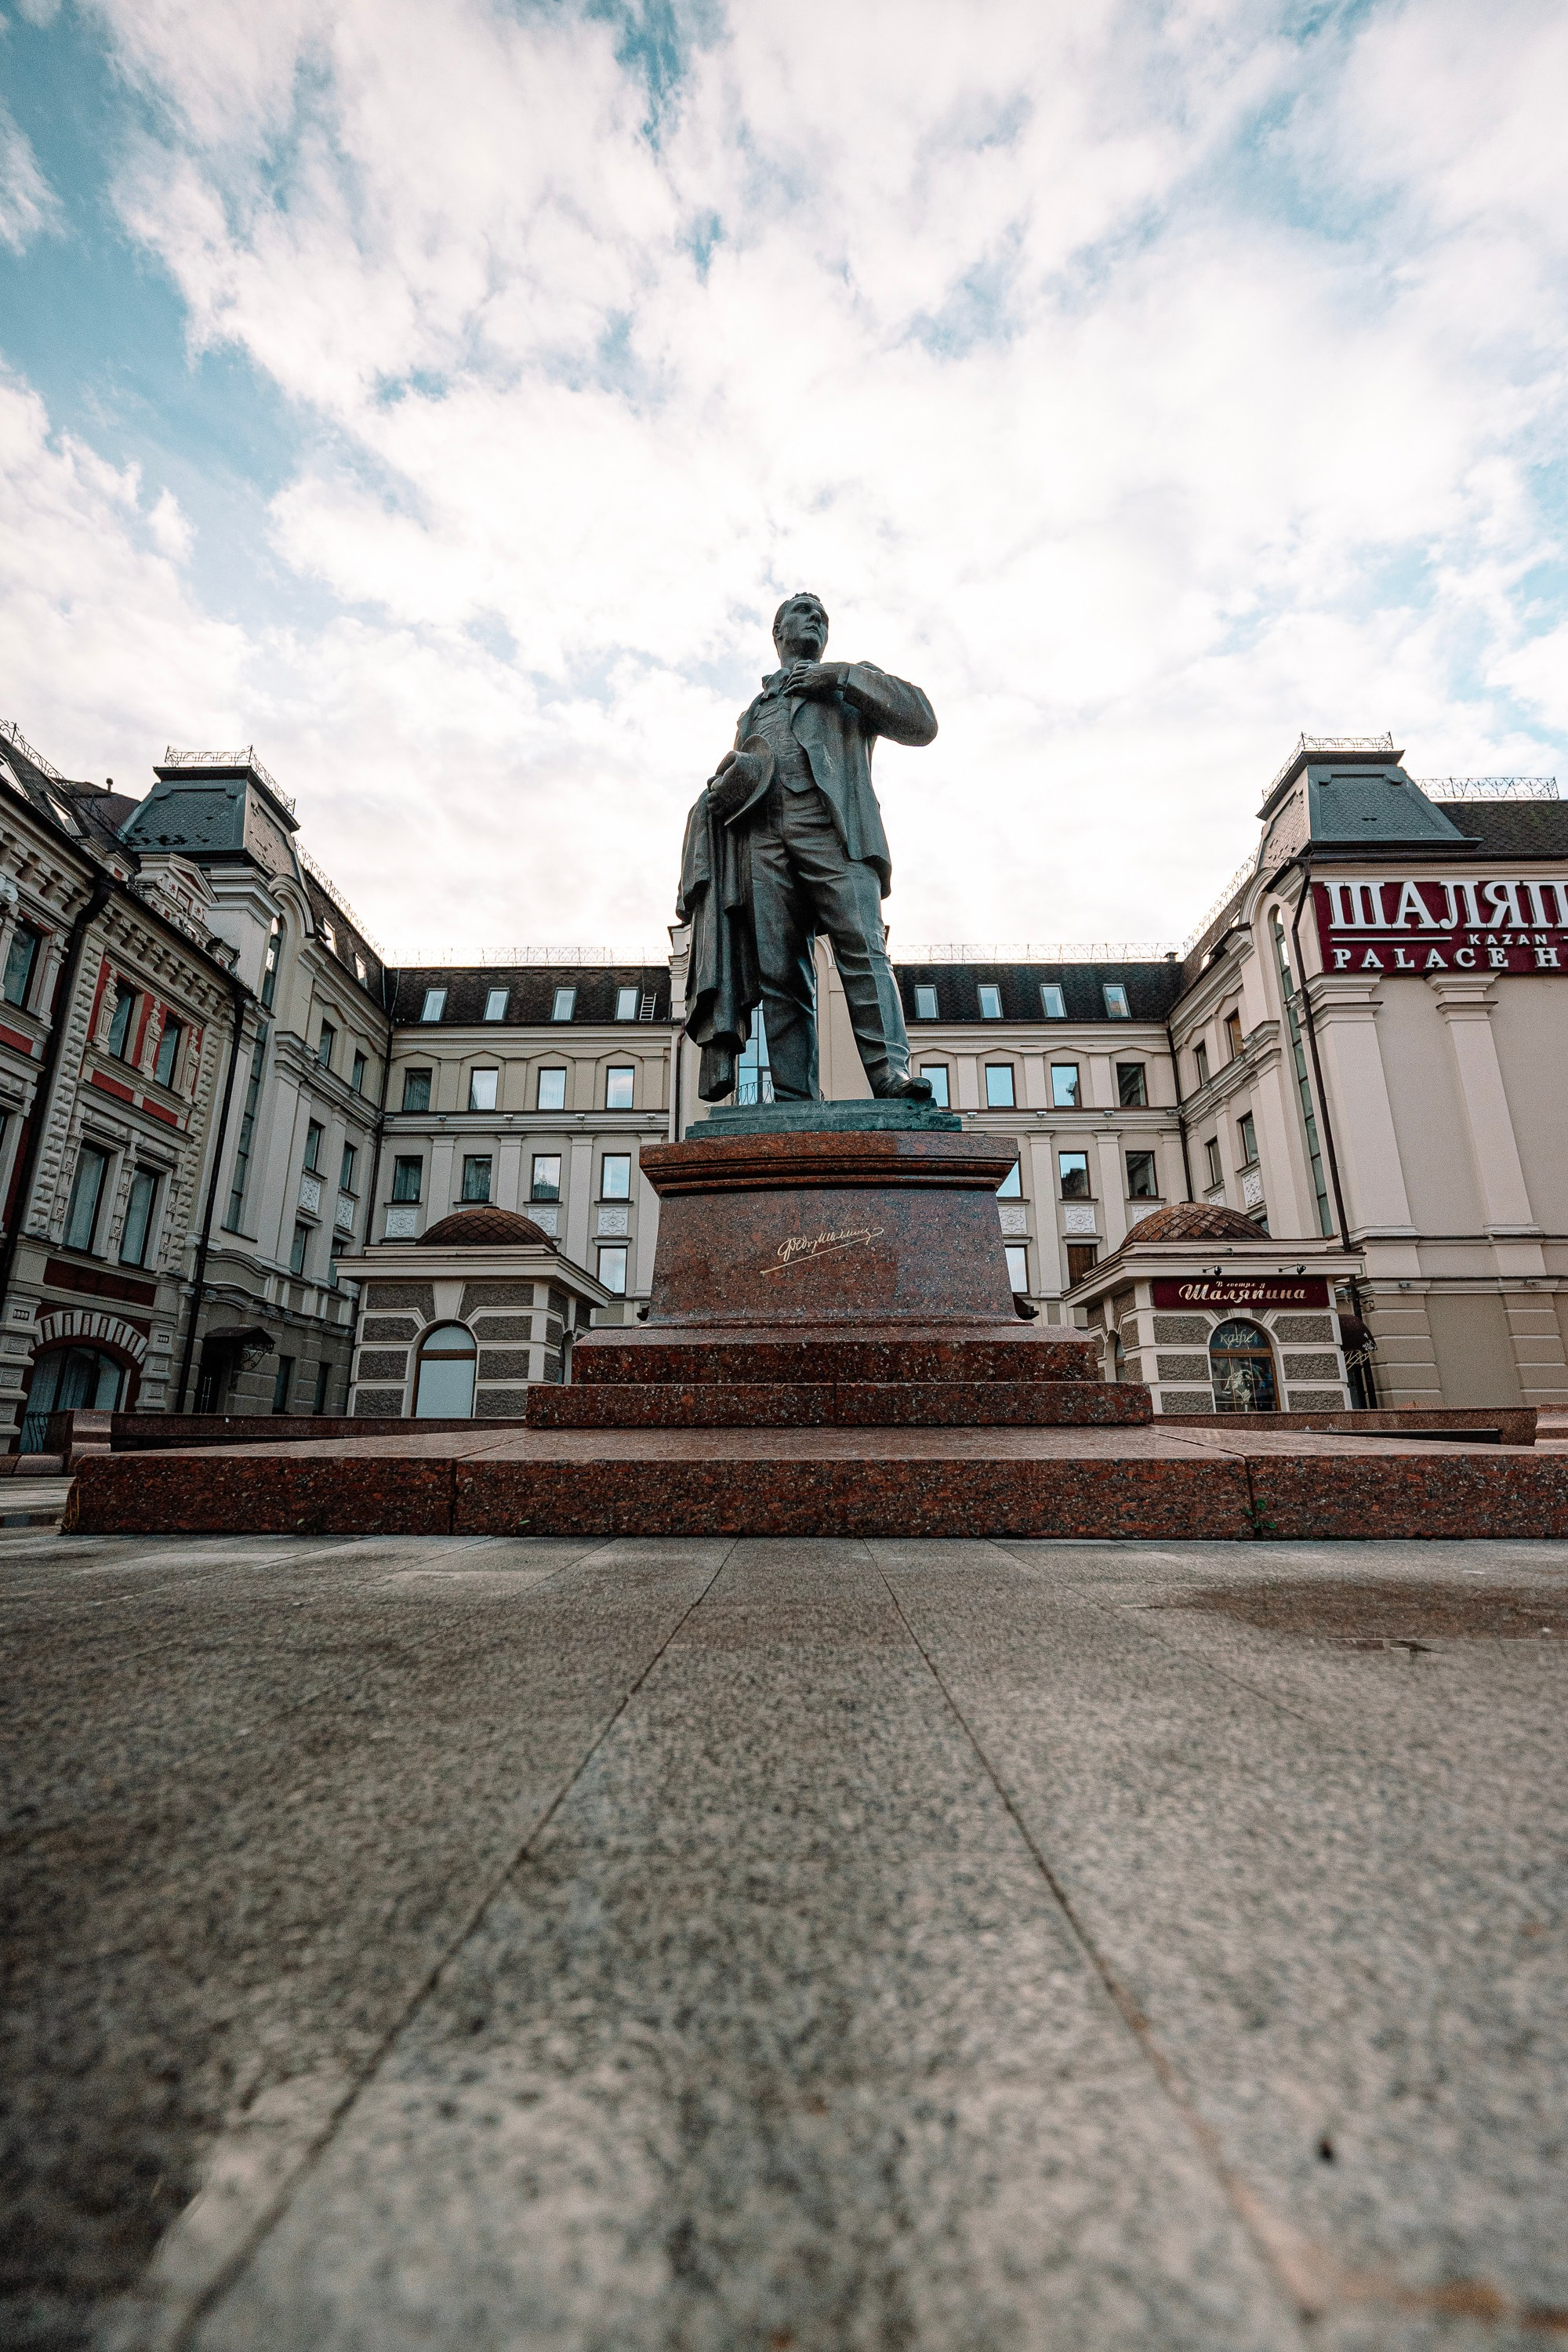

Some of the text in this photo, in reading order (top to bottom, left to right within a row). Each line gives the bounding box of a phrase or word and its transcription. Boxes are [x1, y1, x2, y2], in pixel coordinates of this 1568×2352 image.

[1468, 934, 1548, 946] KAZAN
[1333, 947, 1509, 969] PALACE
[1178, 1283, 1307, 1304] Шаляпина
